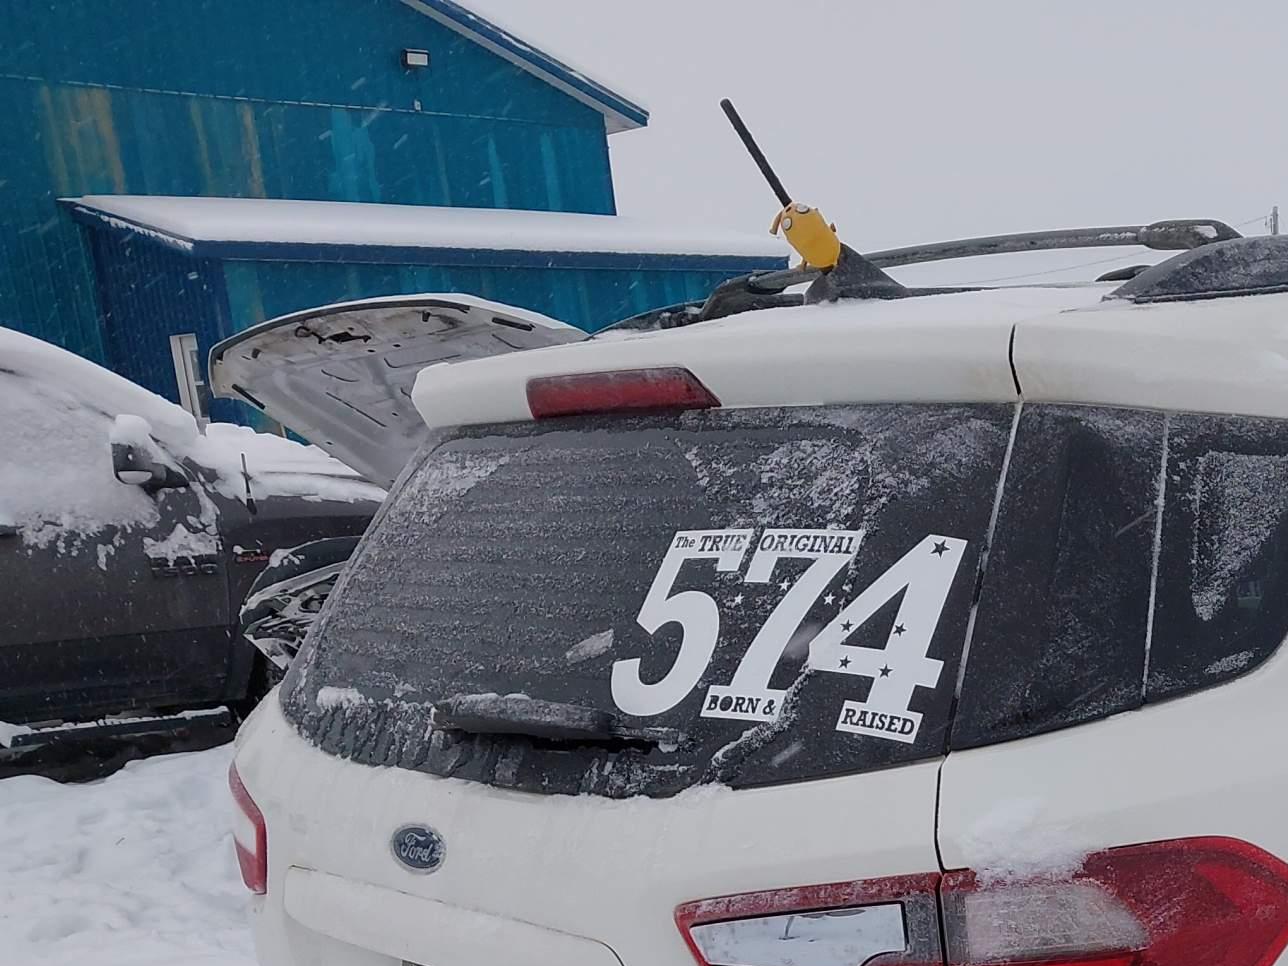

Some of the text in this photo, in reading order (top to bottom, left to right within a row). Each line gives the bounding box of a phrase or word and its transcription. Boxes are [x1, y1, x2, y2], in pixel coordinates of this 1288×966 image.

[674, 534, 857, 554] The TRUE ORIGINAL
[611, 529, 968, 743] 574
[706, 694, 776, 716] BORN &
[841, 708, 915, 736] RAISED
[400, 832, 434, 862] Ford
